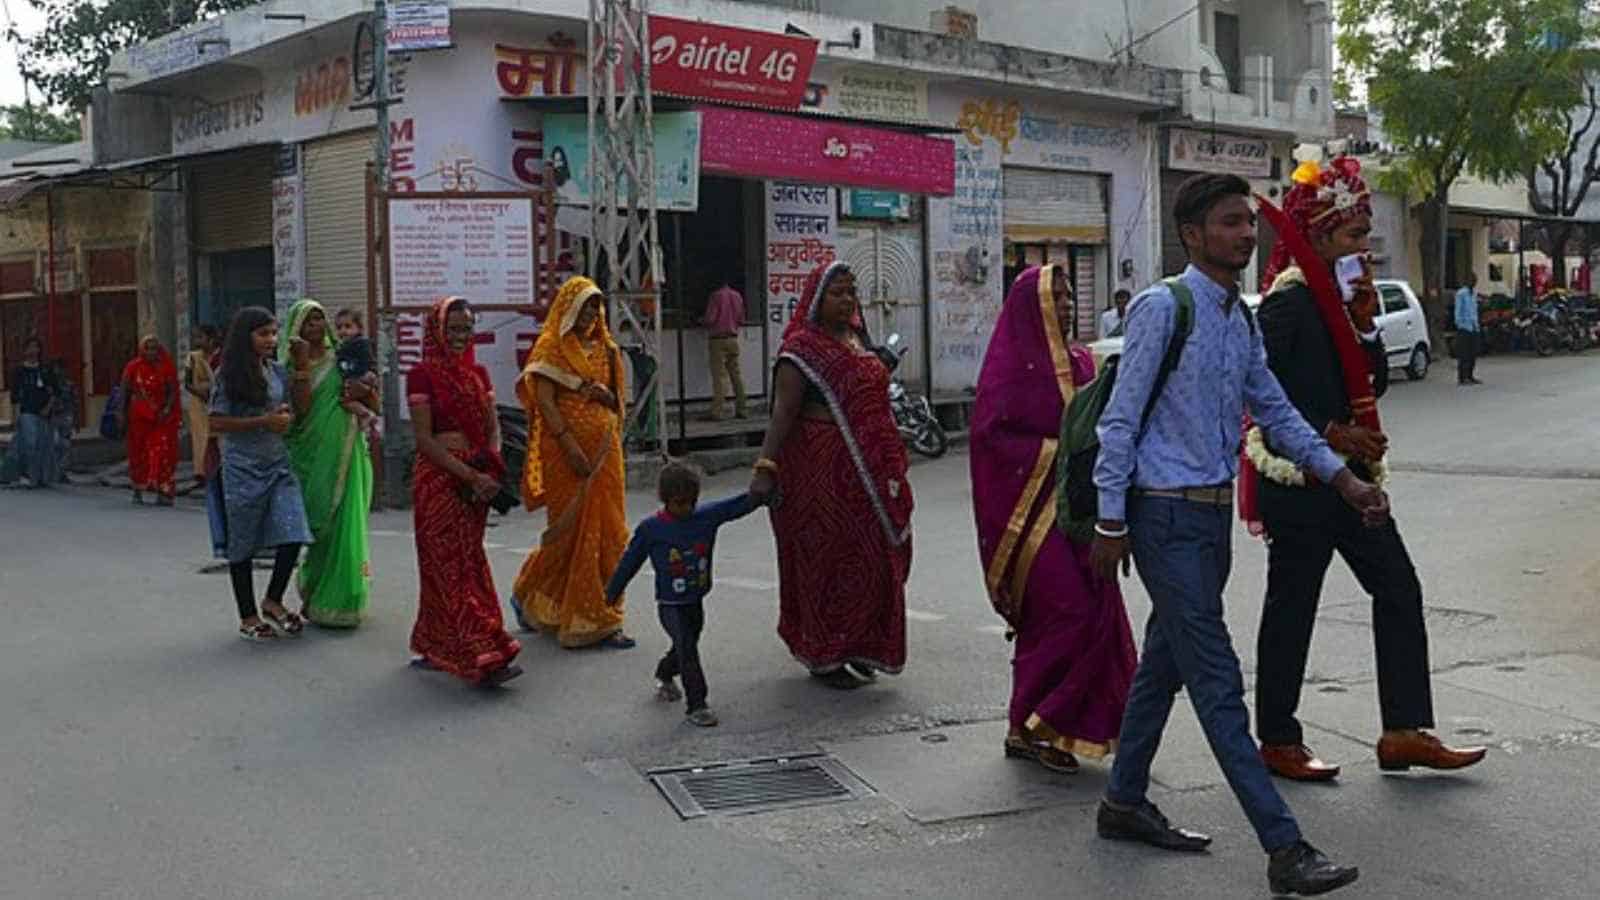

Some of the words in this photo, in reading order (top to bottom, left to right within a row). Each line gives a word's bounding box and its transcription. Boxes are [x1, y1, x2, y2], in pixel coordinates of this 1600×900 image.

[678, 36, 752, 76] airtel
[759, 50, 798, 82] 4G
[823, 137, 848, 158] Jio
[774, 213, 830, 235] सामान
